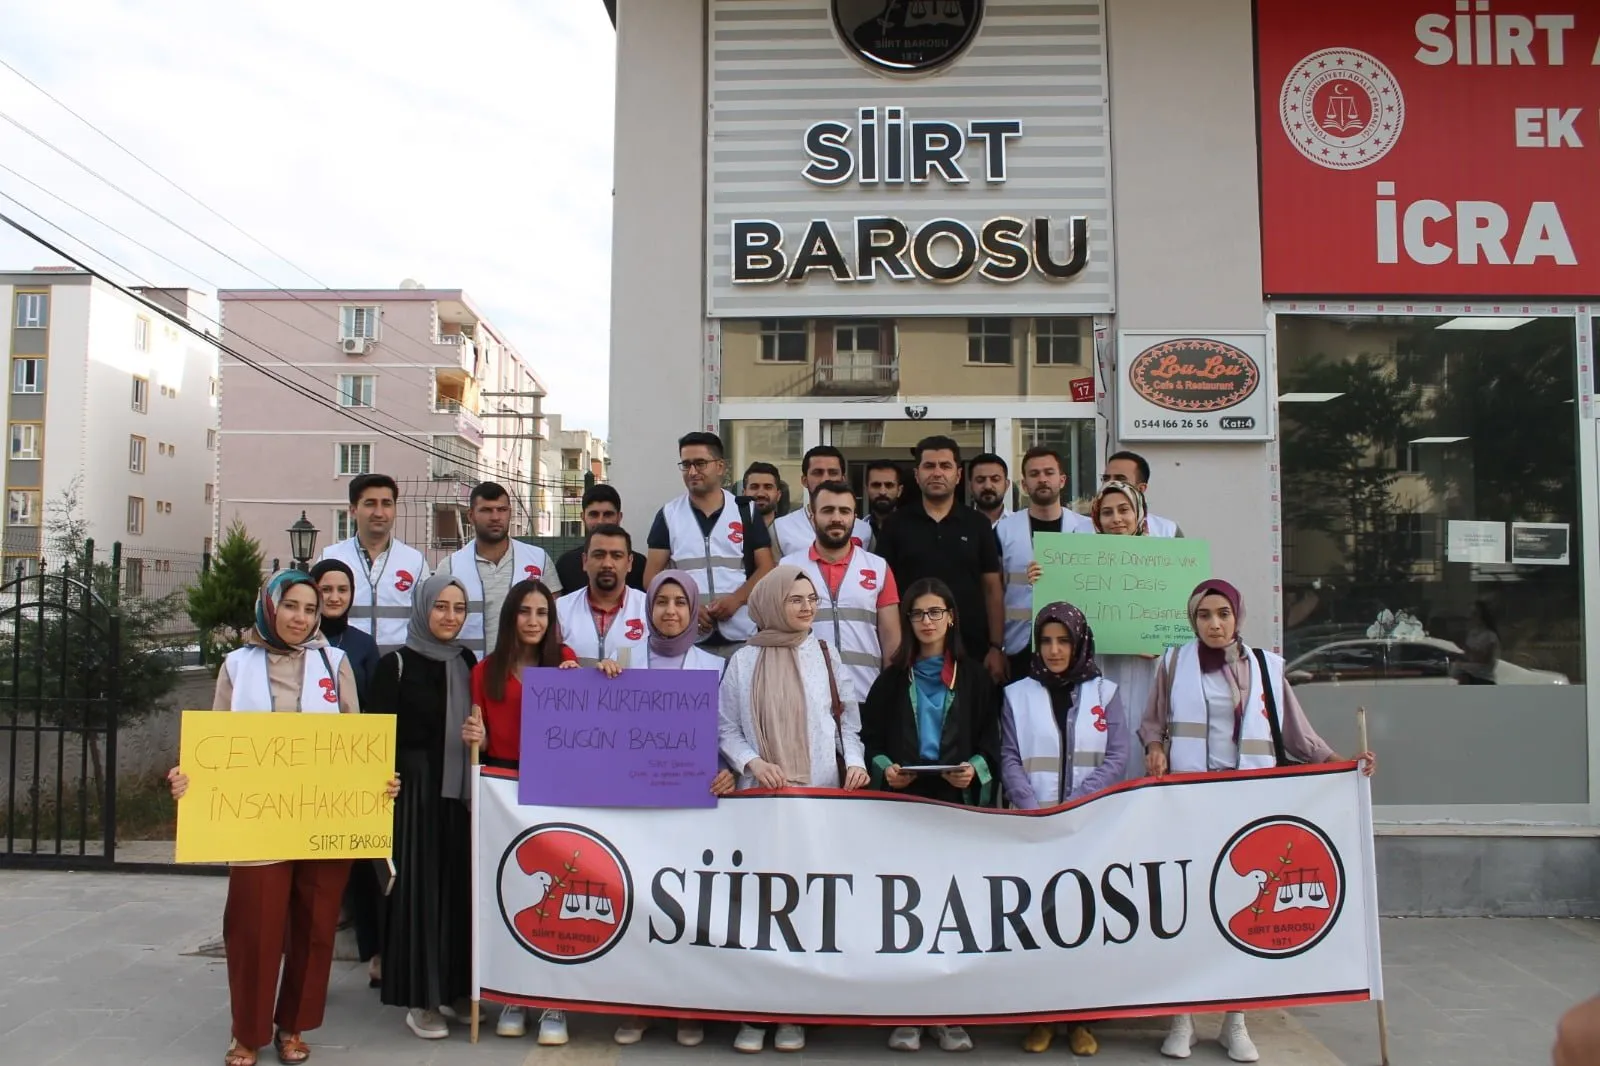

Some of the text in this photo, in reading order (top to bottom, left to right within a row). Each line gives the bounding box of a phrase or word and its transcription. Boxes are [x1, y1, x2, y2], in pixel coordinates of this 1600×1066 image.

[1414, 0, 1575, 66] SİİRT
[1514, 108, 1584, 148] EK
[801, 106, 1023, 185] SİİRT
[1376, 181, 1578, 265] İCRA
[731, 215, 1090, 285] BAROSU
[1151, 354, 1242, 379] Lou Lou
[1078, 385, 1090, 396] 17
[1153, 380, 1234, 391] Cafe & Restaurant
[1163, 419, 1178, 429] 166
[1181, 419, 1193, 429] 26
[1196, 419, 1209, 429] 56
[1222, 418, 1253, 428] Kat:4
[1043, 549, 1093, 566] SADECE
[1074, 573, 1112, 591] SEN
[531, 685, 711, 713] YARINI KURTARMAYA
[314, 731, 388, 765] HAKKI
[545, 725, 617, 750] BUGÜN
[209, 784, 393, 822] İNSAN HAKKIDIR
[349, 834, 392, 851] BAROSU
[649, 849, 1192, 955] SİİRT BAROSU
[558, 930, 600, 943] BAROSU
[1273, 922, 1316, 934] BAROSU
[1271, 937, 1292, 946] 1971
